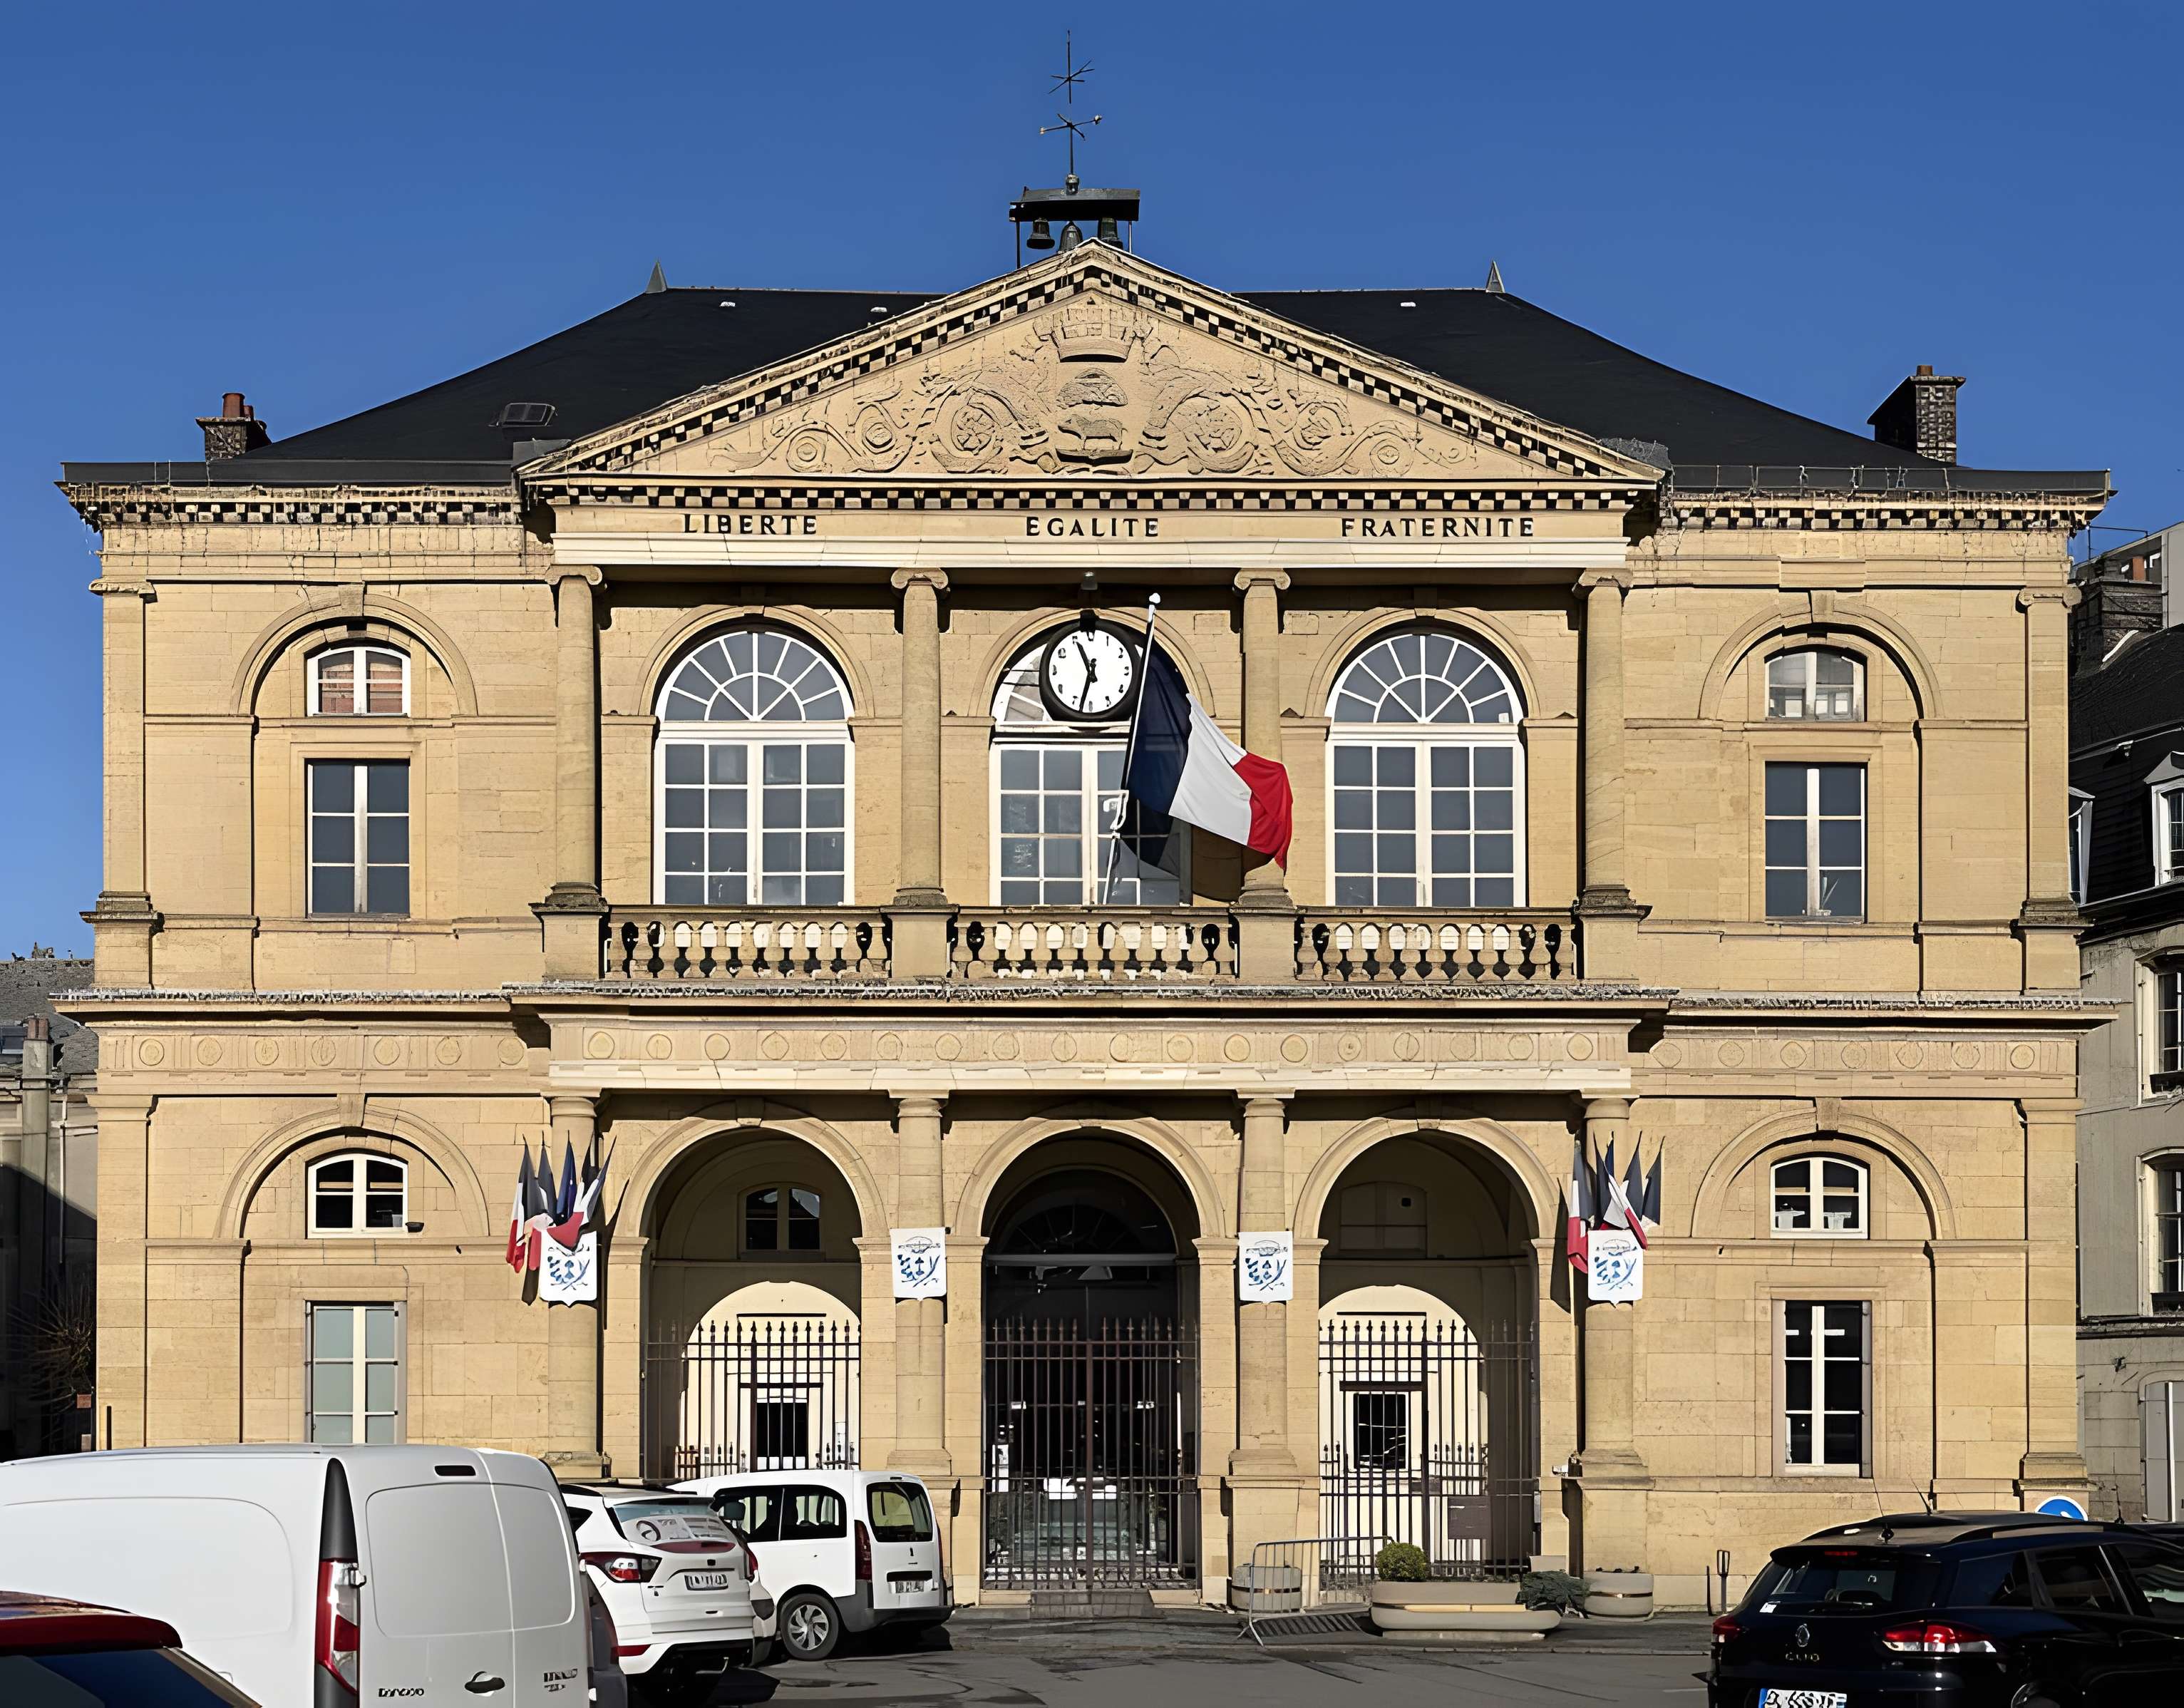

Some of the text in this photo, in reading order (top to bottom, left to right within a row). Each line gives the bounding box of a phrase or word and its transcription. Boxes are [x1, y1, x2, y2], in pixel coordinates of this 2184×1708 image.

[684, 514, 1534, 537] LIBERTE EGALITE FRATERNITE
